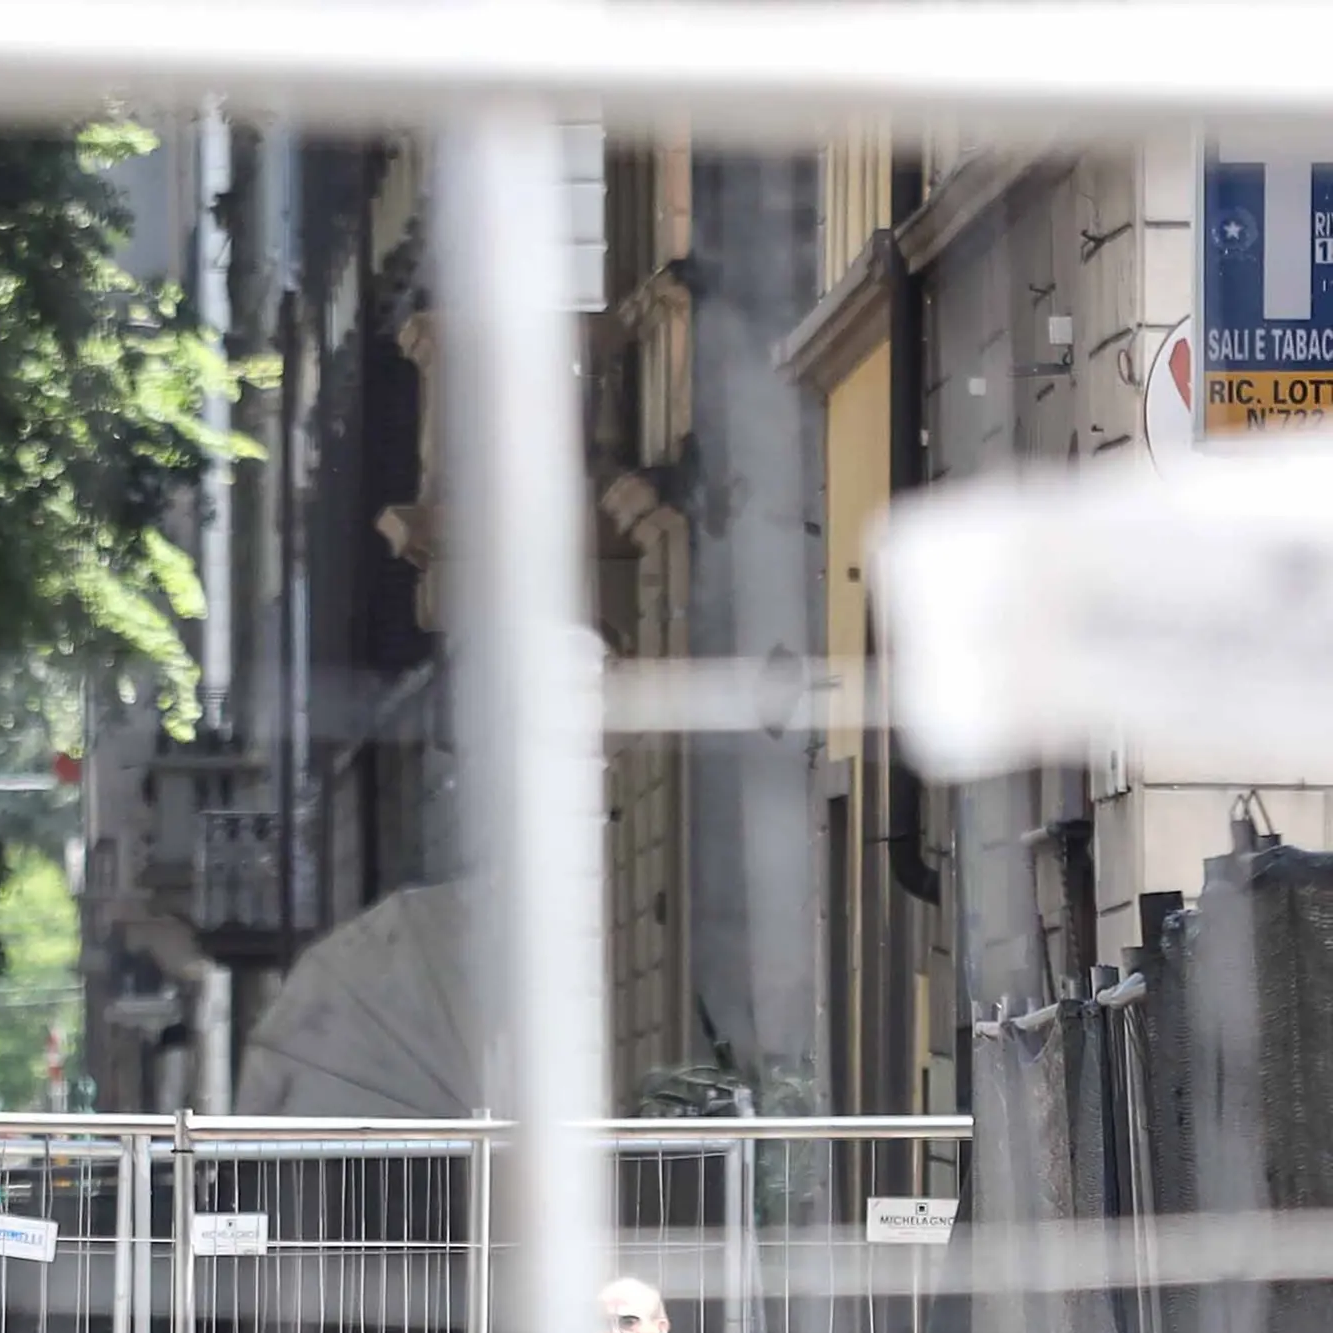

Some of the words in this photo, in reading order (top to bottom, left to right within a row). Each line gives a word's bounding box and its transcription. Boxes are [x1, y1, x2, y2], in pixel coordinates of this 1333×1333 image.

[1208, 328, 1250, 361] SALI
[1254, 328, 1266, 360] E
[1209, 379, 1262, 404] RIC.
